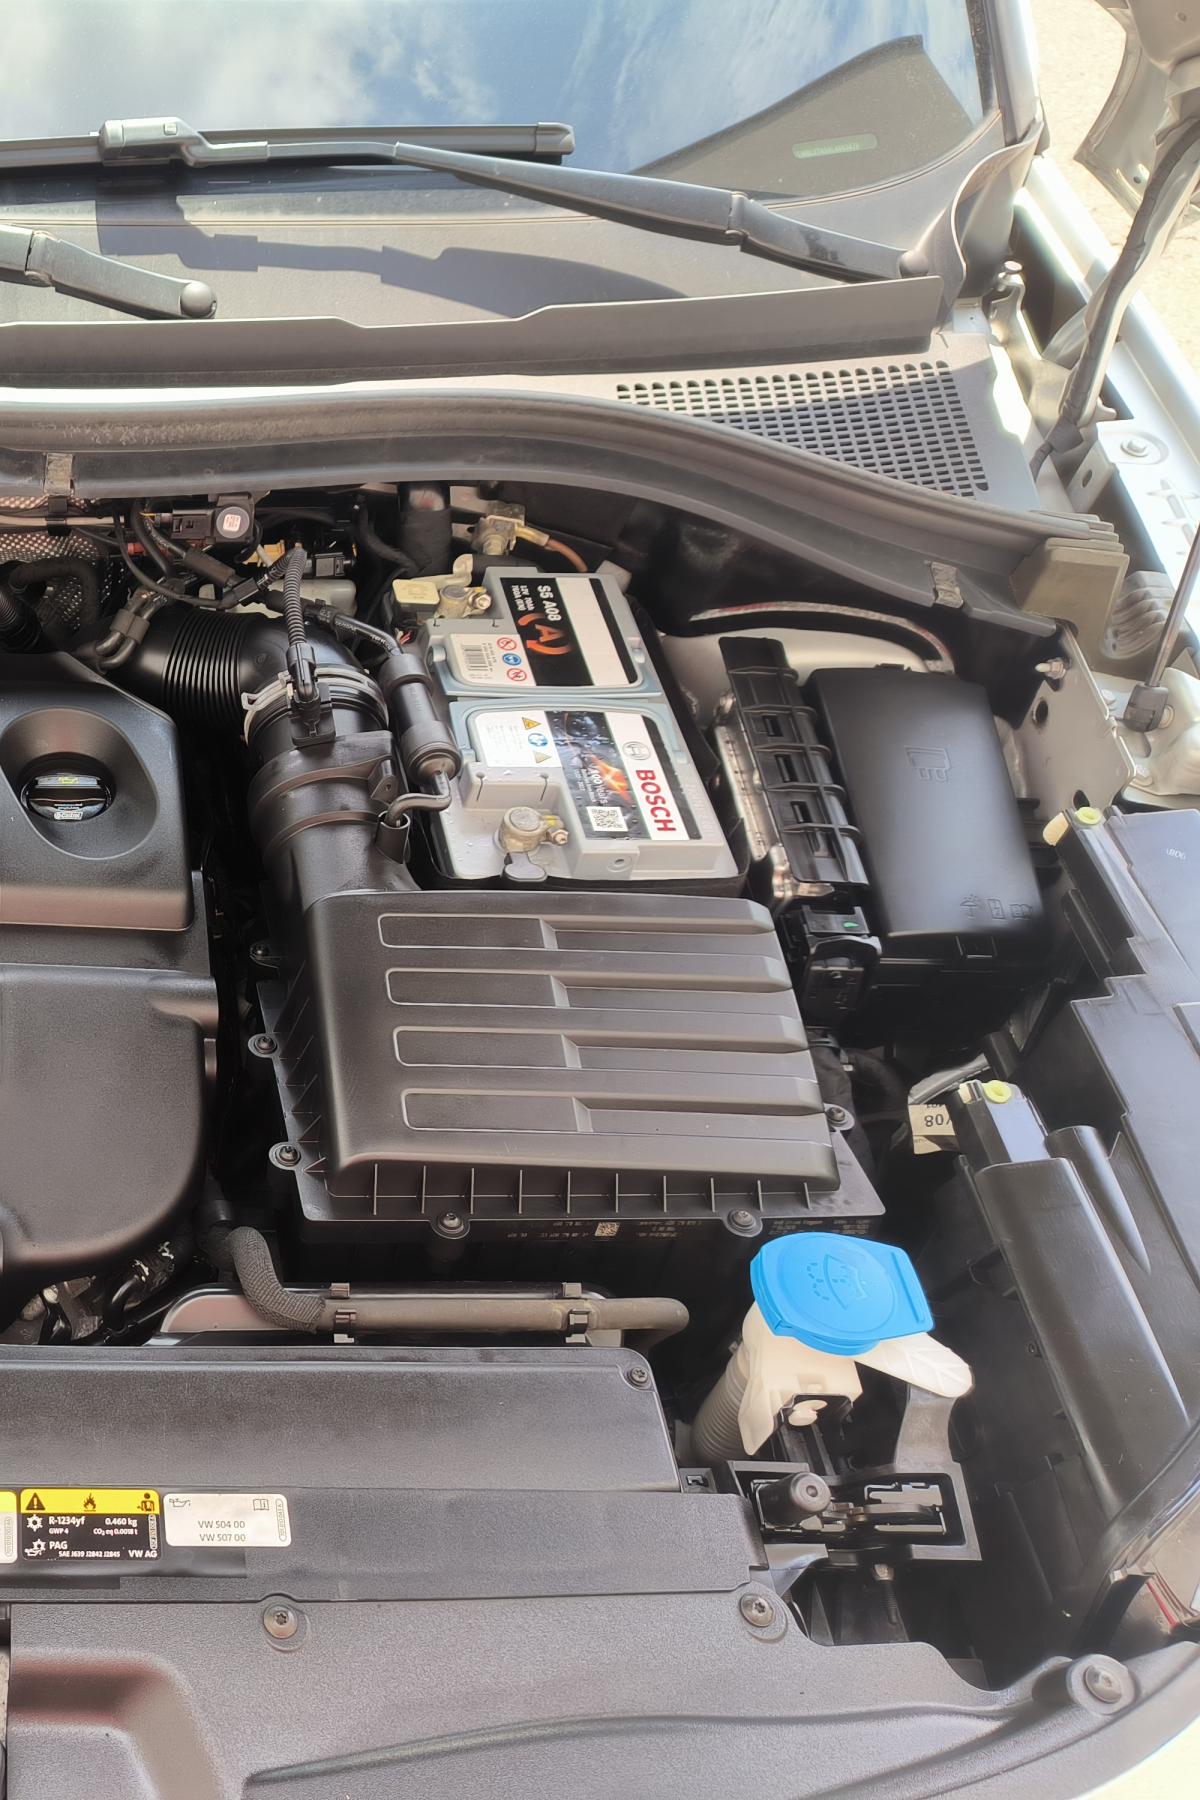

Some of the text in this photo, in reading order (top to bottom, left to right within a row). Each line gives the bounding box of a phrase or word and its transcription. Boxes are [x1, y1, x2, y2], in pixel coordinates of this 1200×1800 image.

[537, 585, 563, 621] S5 A08
[635, 769, 677, 832] BOSCH
[49, 1516, 86, 1528] R-1234yf
[128, 1518, 138, 1528] kg
[198, 1520, 246, 1528] VW 504 00
[200, 1533, 246, 1542] VW 507 00
[50, 1541, 68, 1550] PAG
